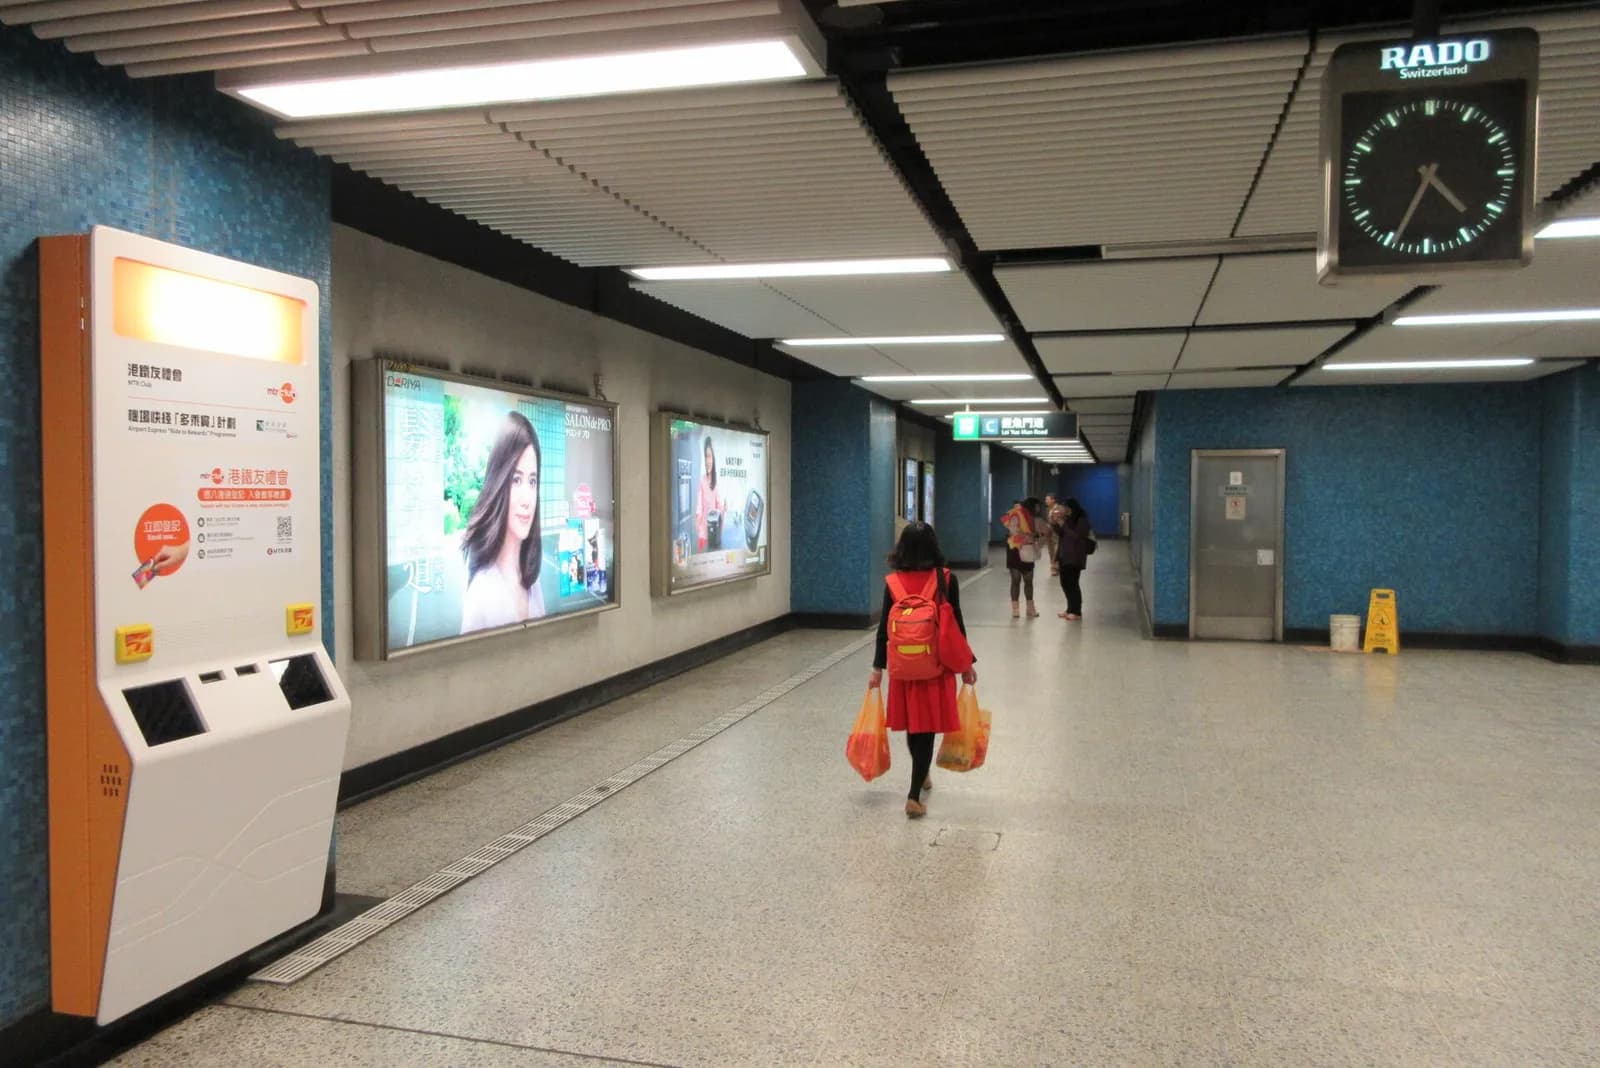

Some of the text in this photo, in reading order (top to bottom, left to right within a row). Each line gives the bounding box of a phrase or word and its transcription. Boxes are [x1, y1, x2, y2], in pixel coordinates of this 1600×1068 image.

[1380, 39, 1490, 70] RADO
[1399, 64, 1469, 79] Switzerland
[985, 419, 995, 433] C
